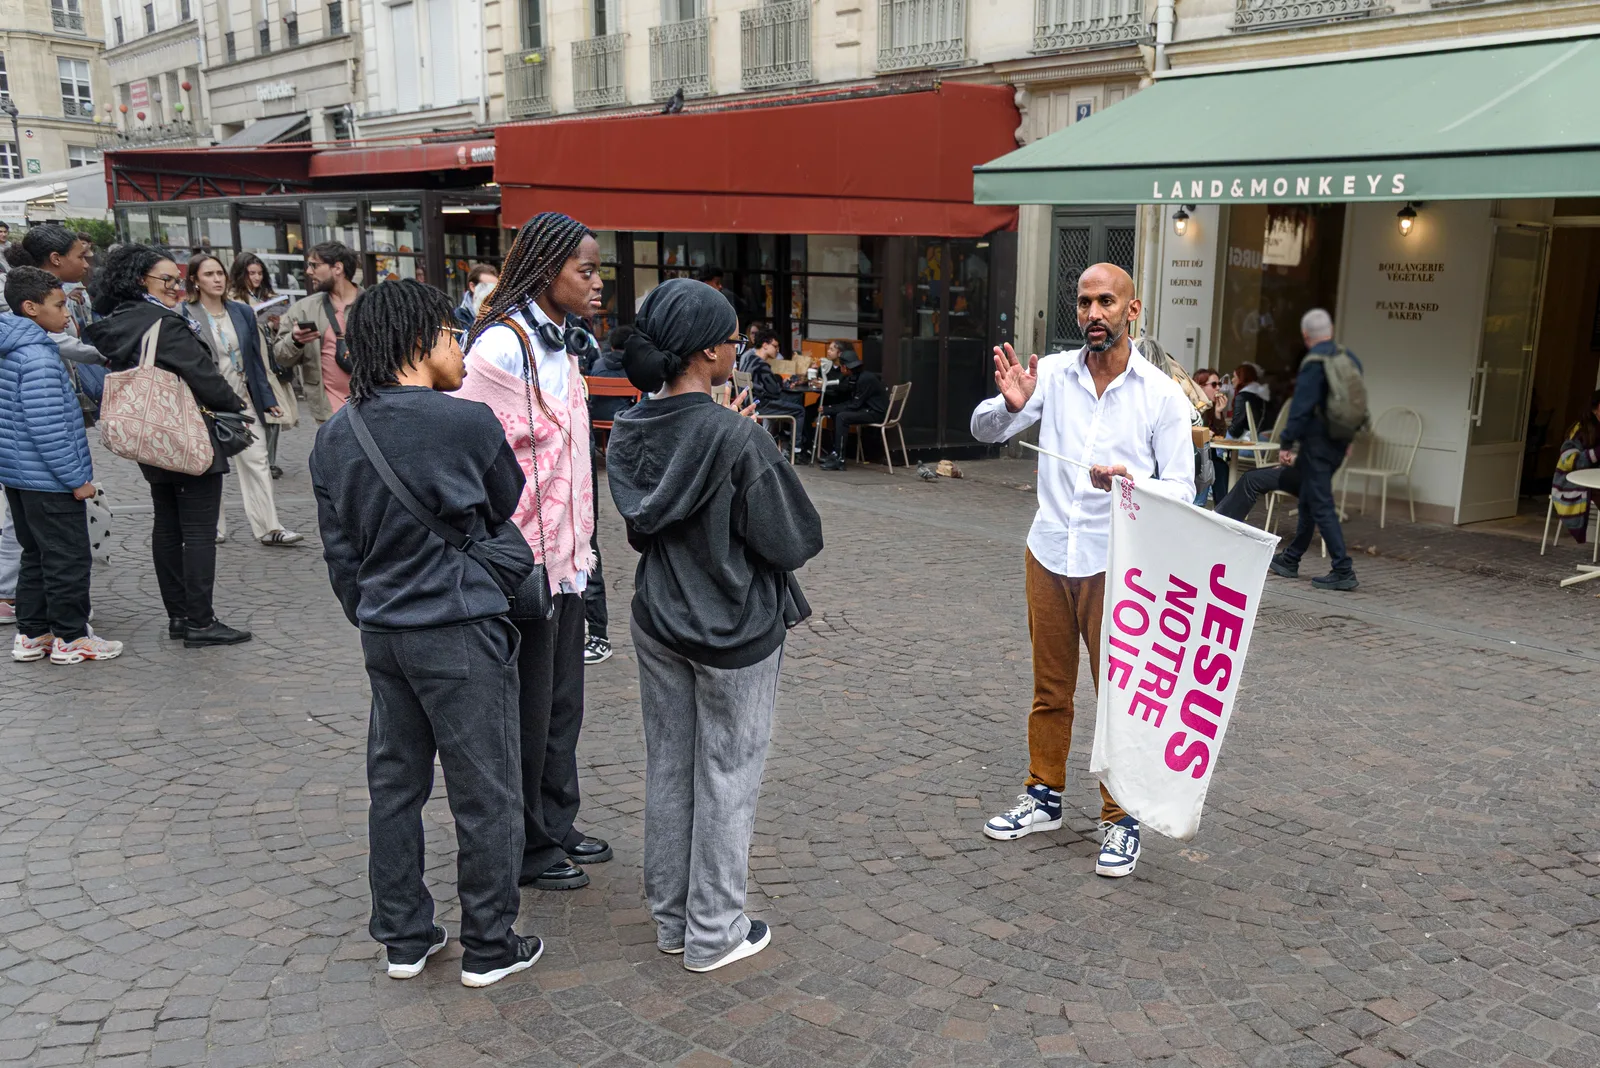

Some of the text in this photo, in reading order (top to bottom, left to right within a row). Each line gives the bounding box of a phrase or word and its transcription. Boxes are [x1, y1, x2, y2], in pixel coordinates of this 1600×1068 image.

[1152, 173, 1406, 198] LAND&MONKEYS
[1171, 257, 1204, 268] PETIT DÉJ
[1378, 262, 1445, 272] BOULANGERIE
[1170, 276, 1202, 287] DÉJEUNER
[1171, 296, 1198, 307] GOÛTER
[1375, 301, 1440, 312] PLANT-BASED
[1387, 311, 1424, 321] BAKERY
[1127, 573, 1198, 729] NOTRE
[1164, 563, 1248, 779] JESUS
